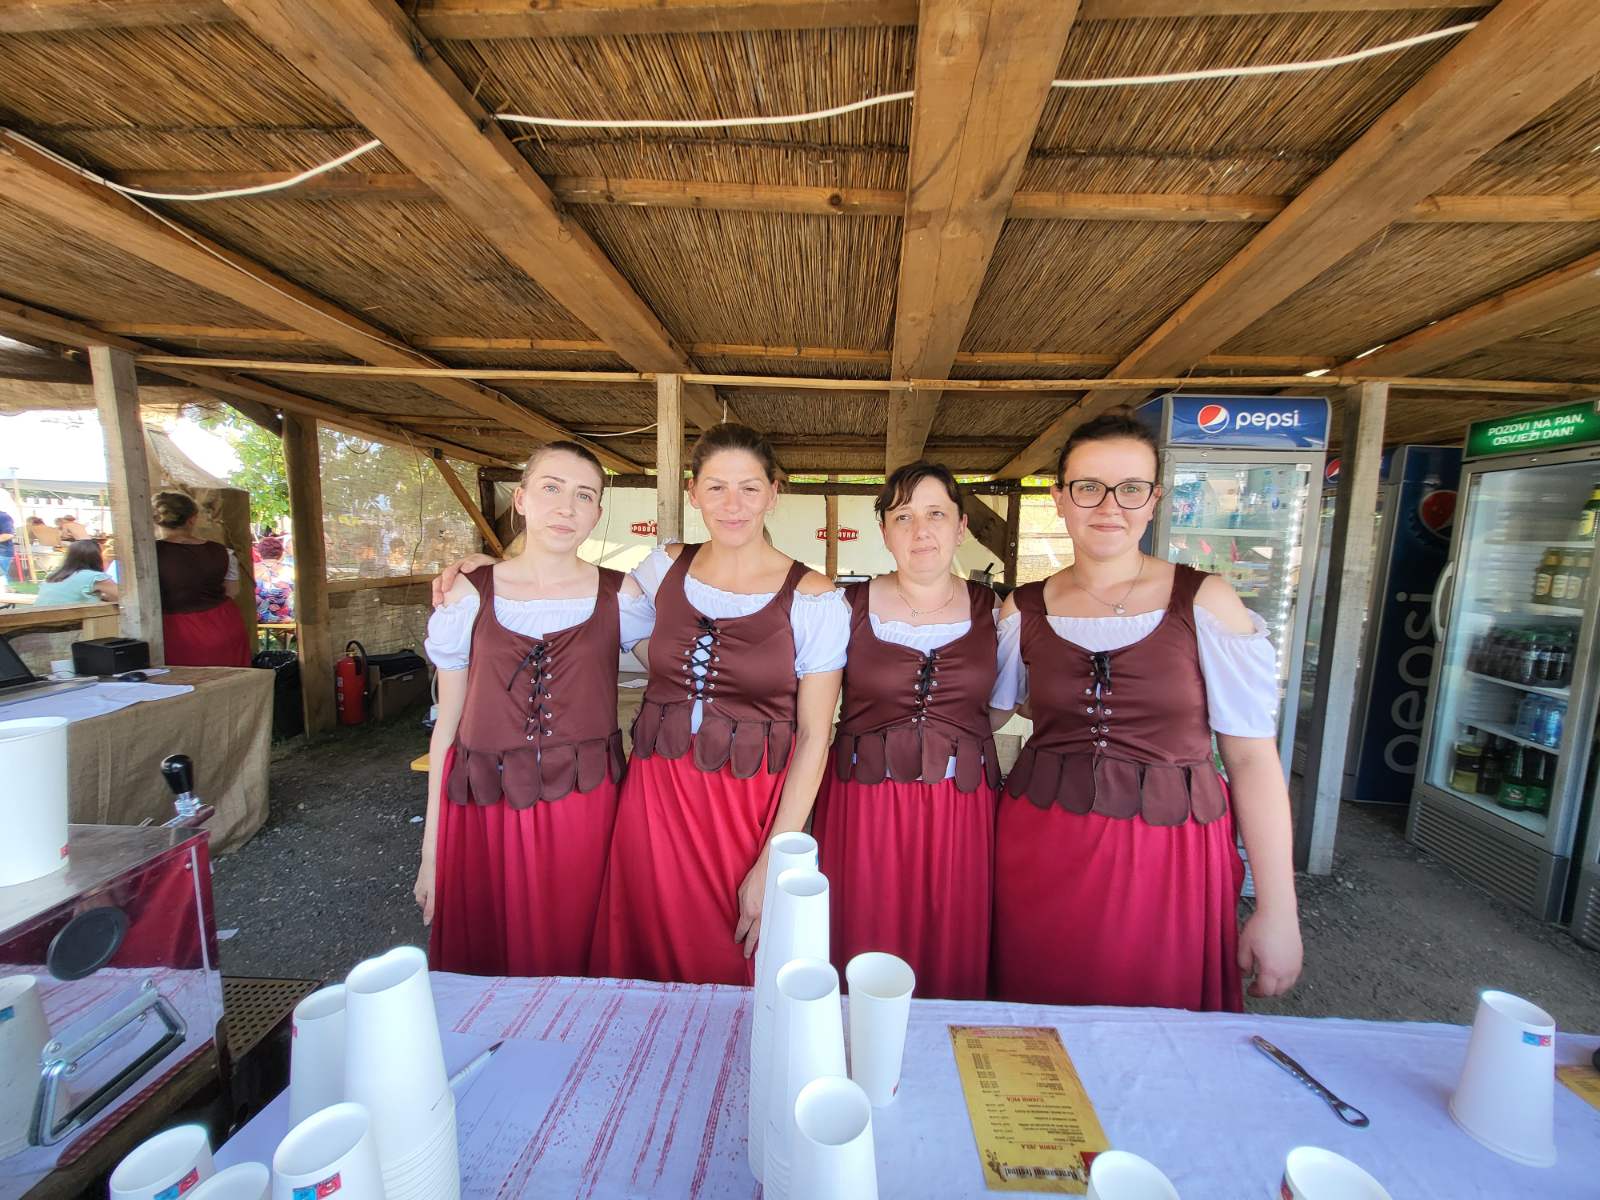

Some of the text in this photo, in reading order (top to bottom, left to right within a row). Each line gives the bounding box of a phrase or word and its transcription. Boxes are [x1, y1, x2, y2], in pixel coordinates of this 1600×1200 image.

[1235, 410, 1299, 430] pepsi
[1488, 421, 1530, 436] POZOVI
[1533, 418, 1551, 429] NA
[1542, 426, 1575, 439] DAN!
